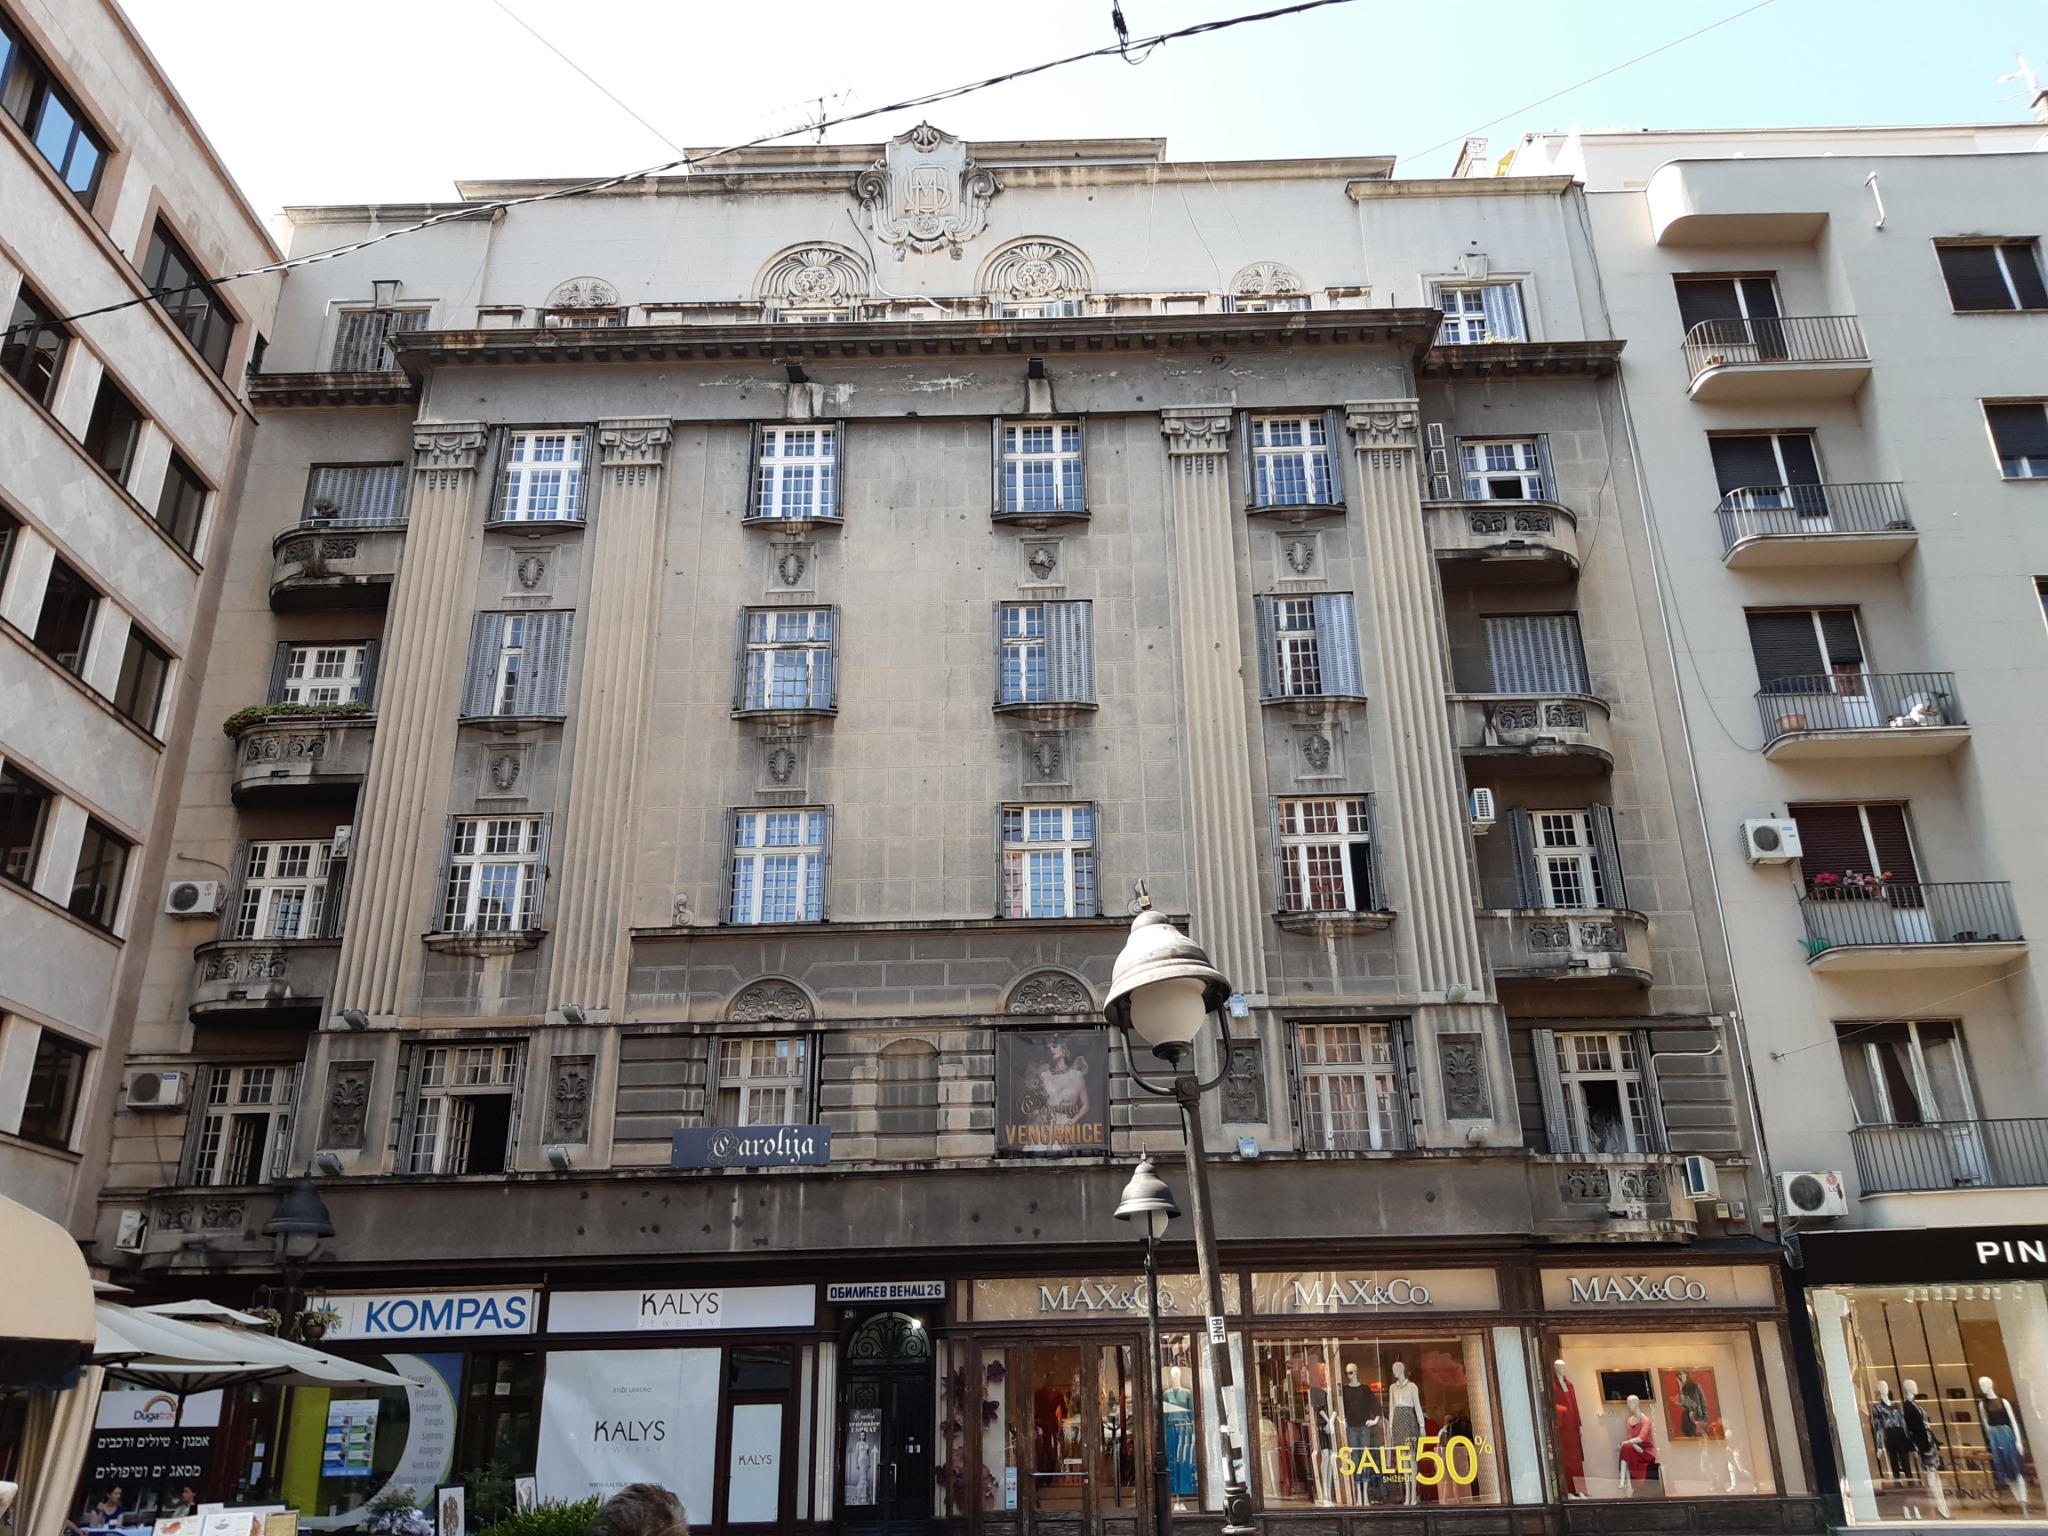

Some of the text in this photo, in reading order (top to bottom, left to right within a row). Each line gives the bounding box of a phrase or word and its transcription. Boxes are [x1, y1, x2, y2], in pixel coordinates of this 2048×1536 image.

[707, 1127, 814, 1166] Carolija
[1975, 1240, 2047, 1264] PIN
[830, 1284, 942, 1299] ОБИЛИЋЕВ ВЕНАЦ 26
[1292, 1278, 1433, 1306] MAX&Co.
[1567, 1274, 1709, 1303] MAX&Co.
[365, 1296, 527, 1332] KOMPAS
[641, 1292, 719, 1316] KALYS
[844, 1310, 854, 1318] 26
[640, 1320, 716, 1328] JEWELRY
[1211, 1318, 1225, 1341] BNE
[594, 1420, 665, 1442] KALYS
[738, 1454, 773, 1466] KALYS
[1338, 1446, 1412, 1475] SALE
[1383, 1474, 1413, 1483] SNIŽENJE
